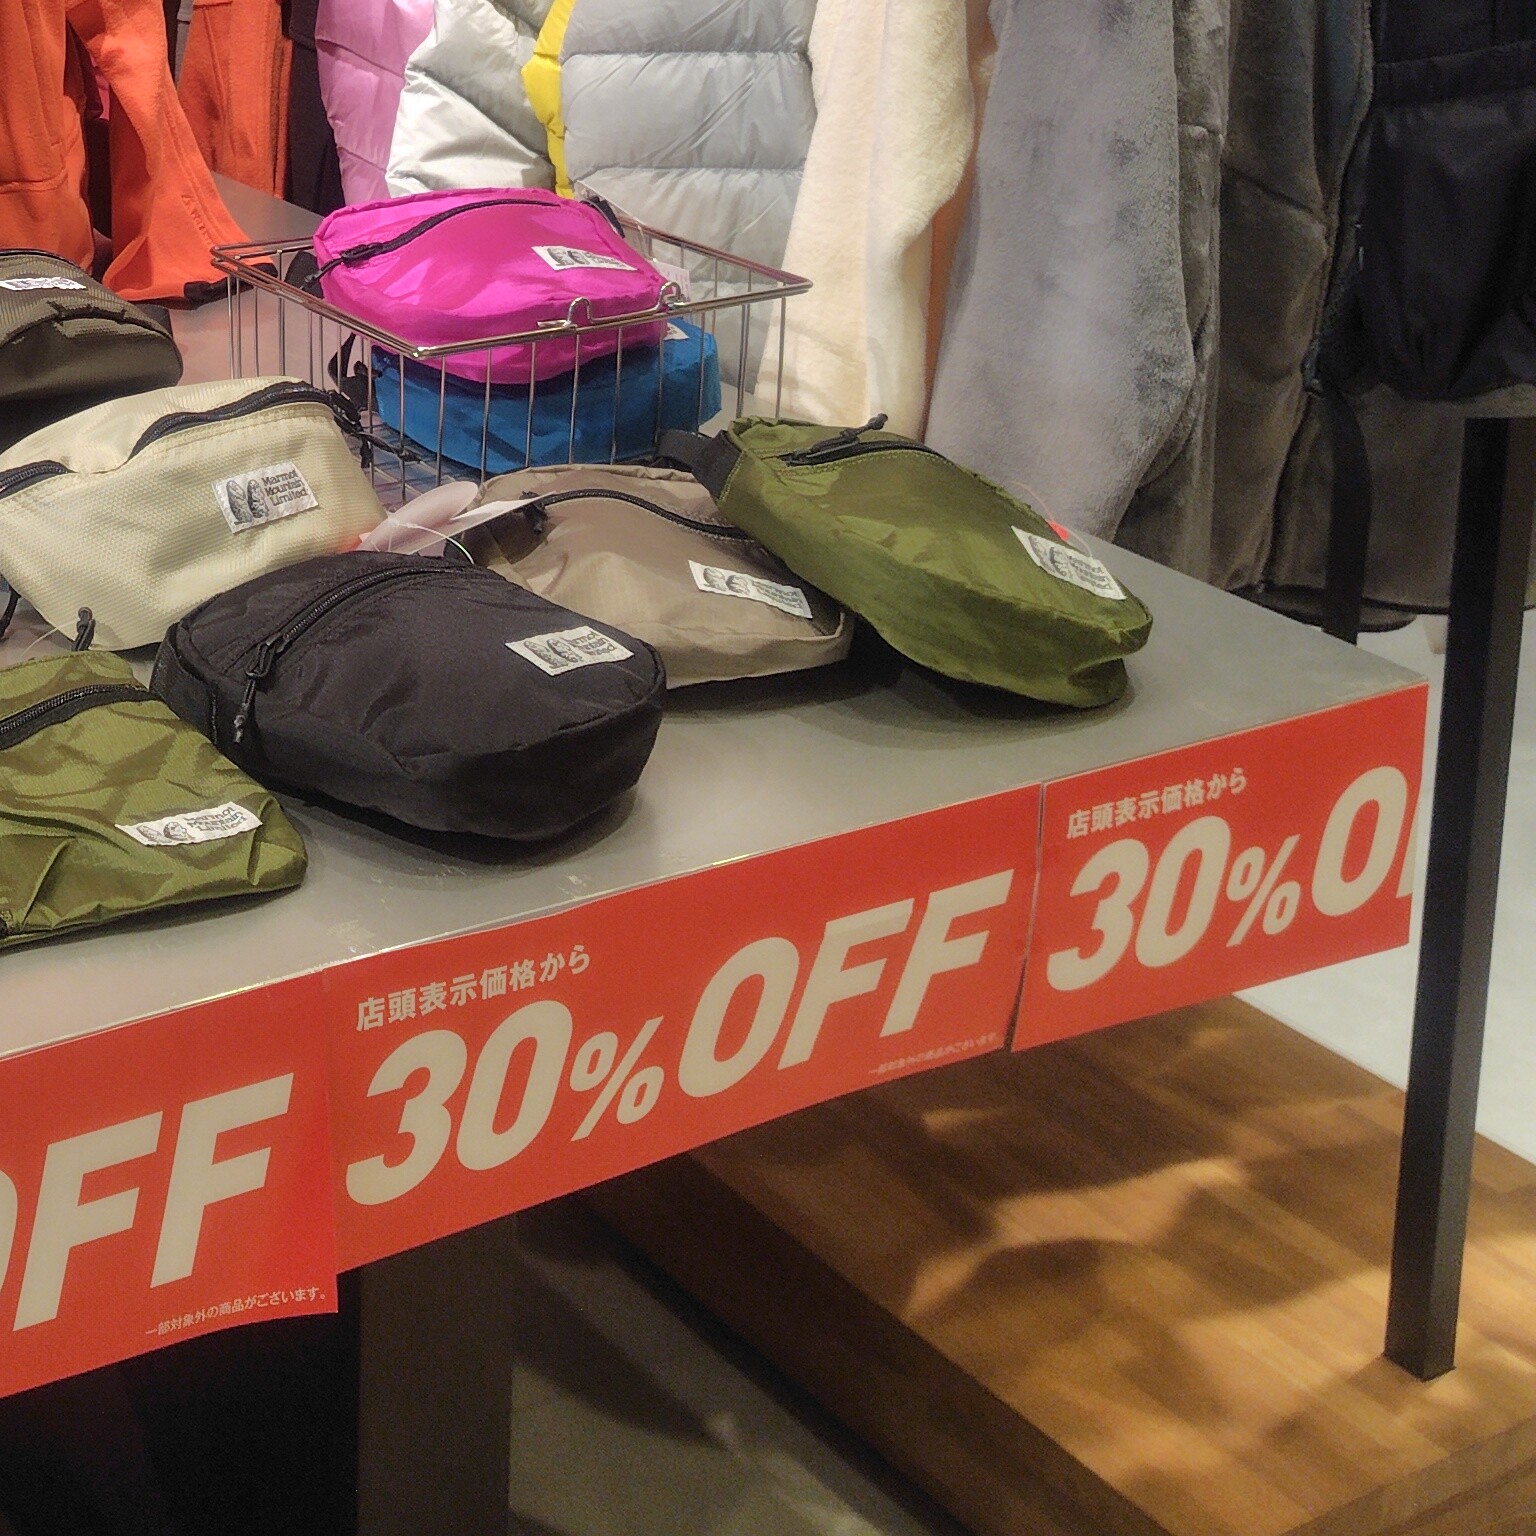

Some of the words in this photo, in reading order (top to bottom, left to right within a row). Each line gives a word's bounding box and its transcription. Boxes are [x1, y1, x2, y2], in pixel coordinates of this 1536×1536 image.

[261, 469, 299, 486] Marmot
[1066, 767, 1248, 840] 店頭表示価格から
[1046, 766, 1419, 992] 30%O
[355, 944, 592, 1032] 店頭表示価格から
[345, 868, 1015, 1206] 30%OFF
[145, 1286, 326, 1336] 一部対象外の商品がございます。
